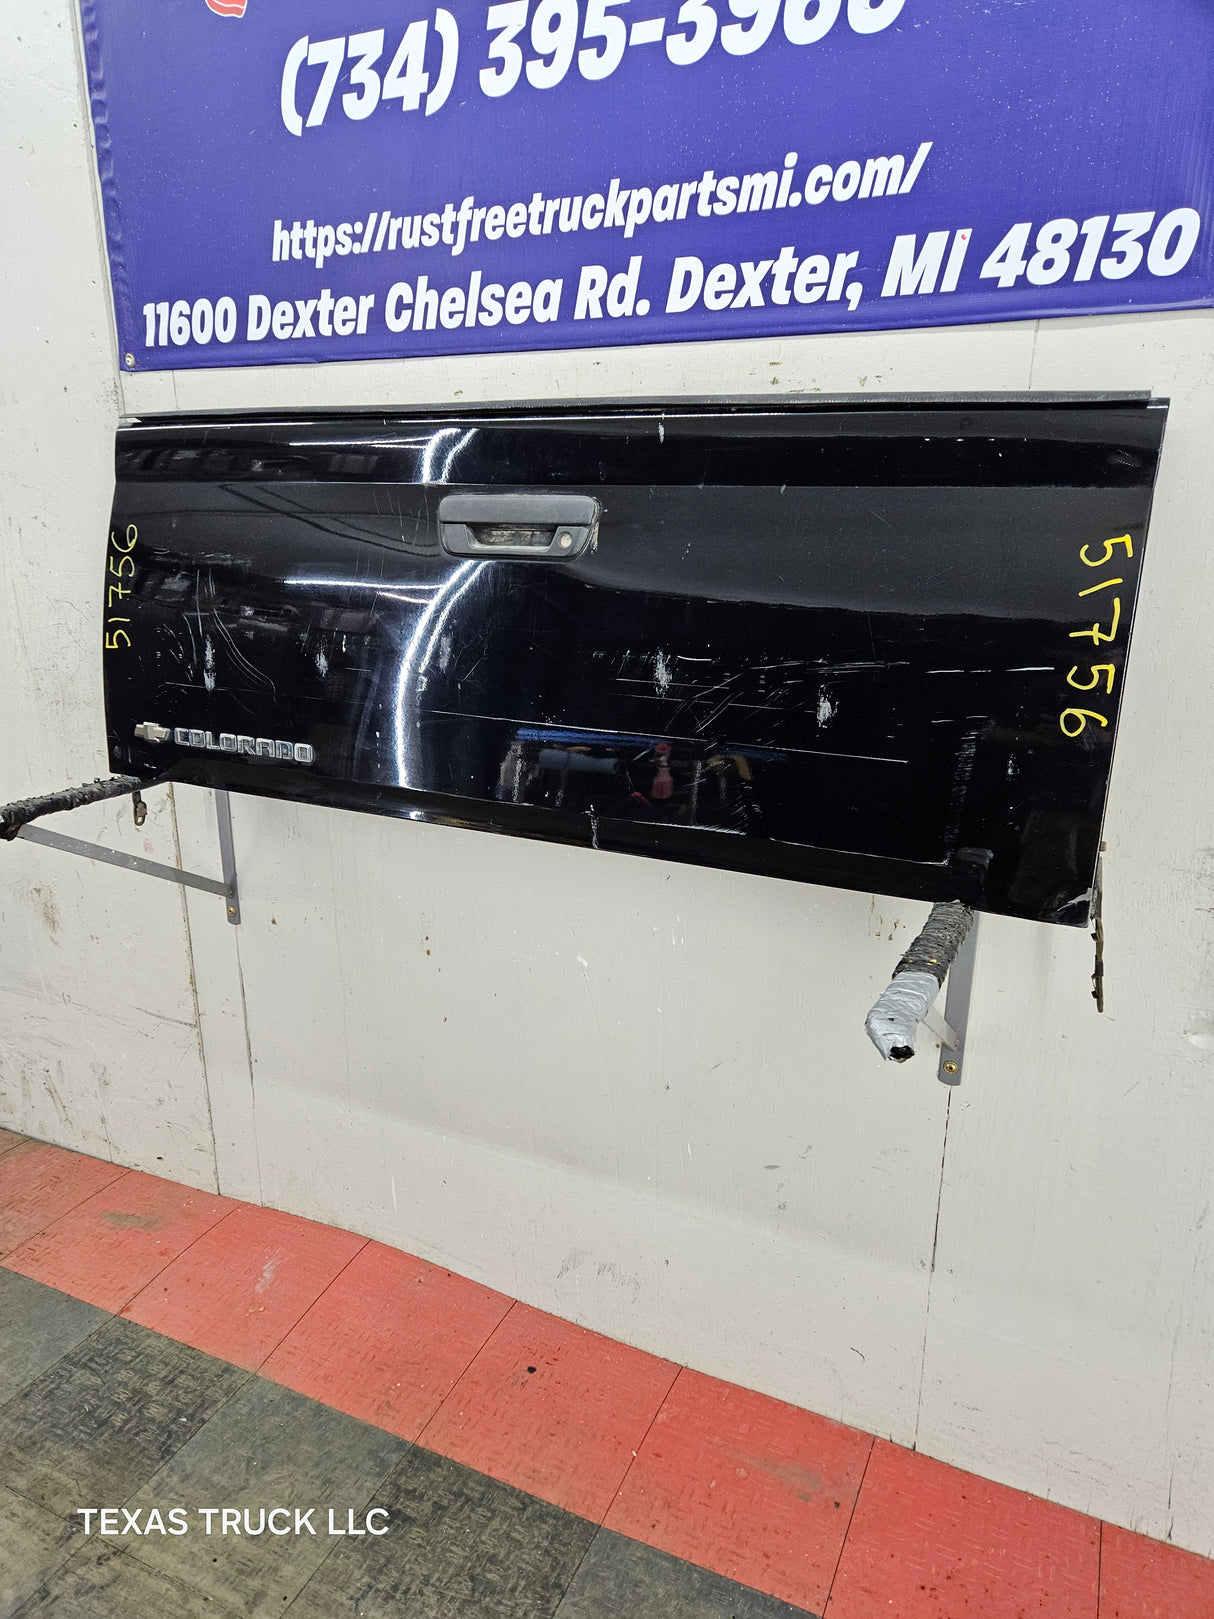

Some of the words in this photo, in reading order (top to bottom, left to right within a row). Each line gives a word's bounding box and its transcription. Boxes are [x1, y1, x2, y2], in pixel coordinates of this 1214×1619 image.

[280, 7, 460, 137] (734)
[271, 141, 934, 270] https://rustfreetruckpartsmi.com/
[142, 296, 237, 348] 11600
[246, 287, 376, 341] Dexter
[384, 270, 564, 333] Chelsea
[573, 255, 651, 320] Rd.
[664, 245, 863, 313] Dexter,
[880, 227, 973, 298] MI
[979, 207, 1201, 289] 48130
[104, 523, 139, 650] 51756
[1058, 533, 1135, 738] 51756
[173, 726, 315, 765] COLORADO
